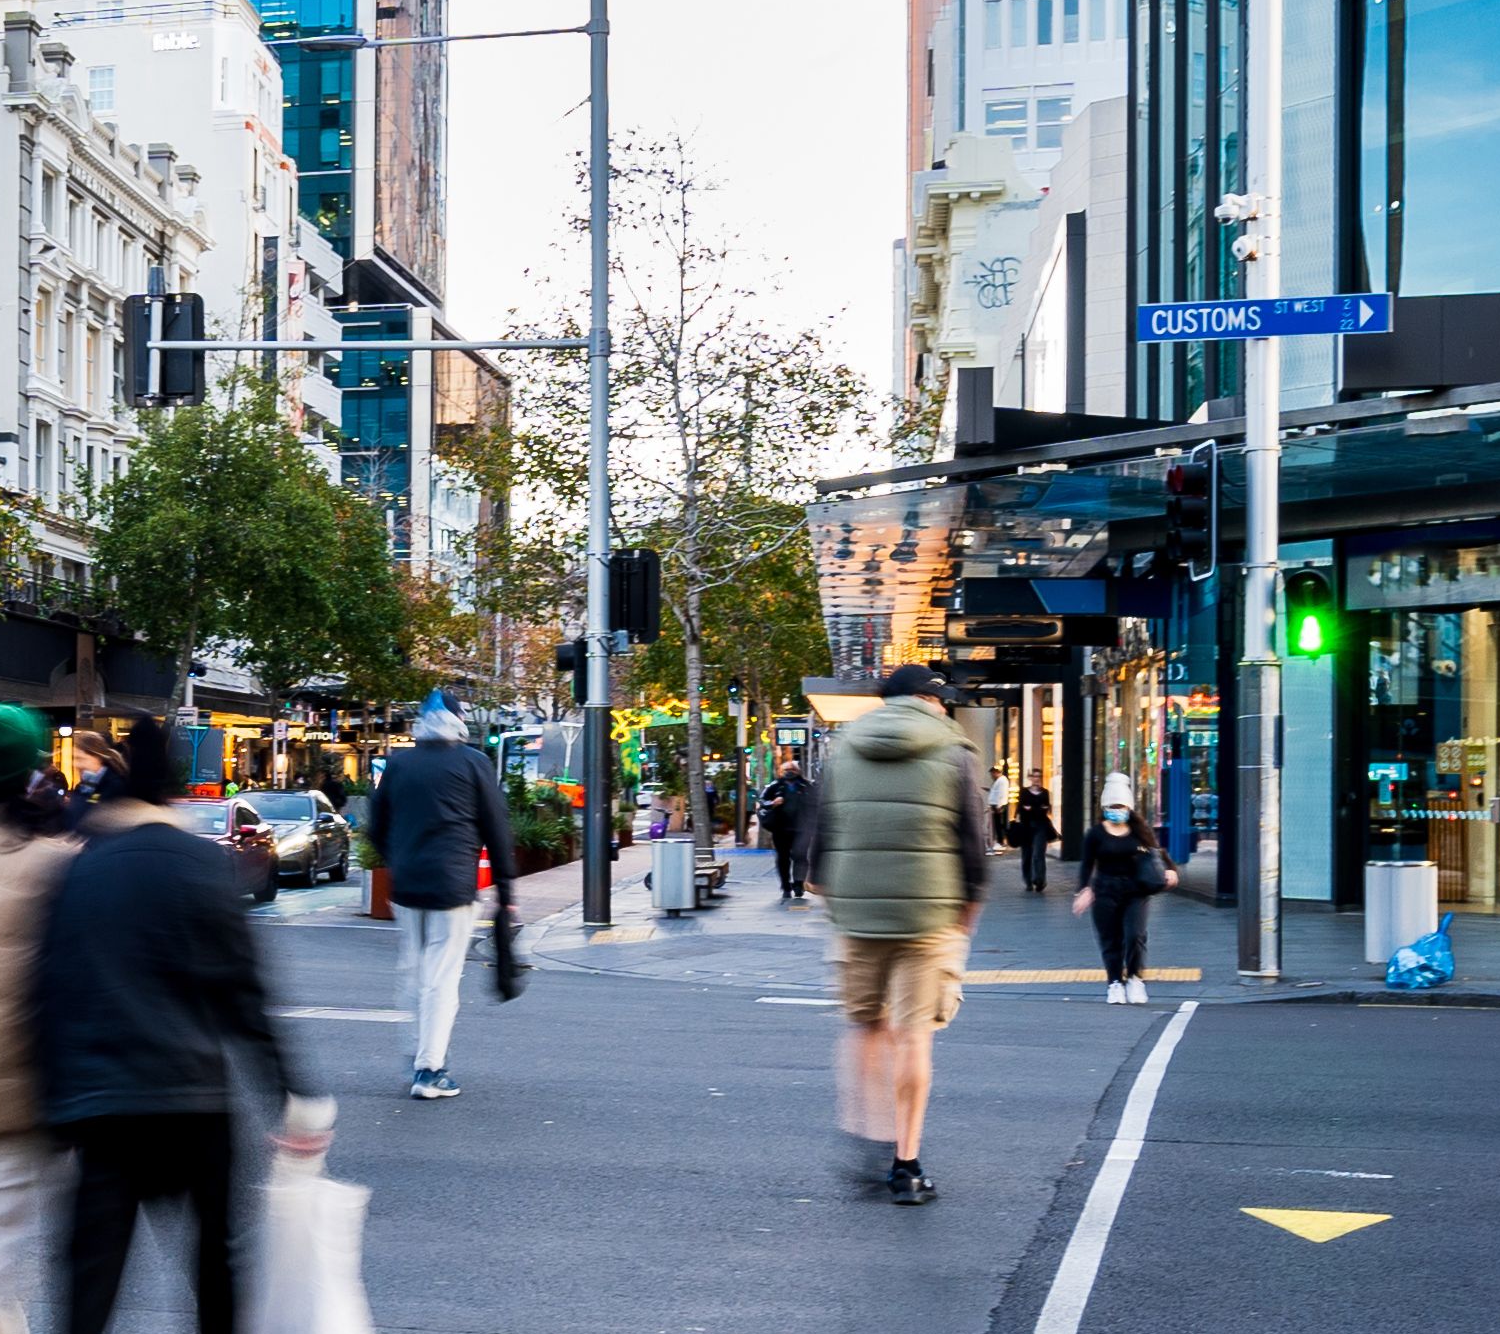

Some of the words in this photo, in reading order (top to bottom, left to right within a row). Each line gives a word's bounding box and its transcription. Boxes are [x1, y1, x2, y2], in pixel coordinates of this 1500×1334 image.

[1344, 299, 1351, 309] 2
[1151, 306, 1261, 335] CUSTOMS
[1274, 301, 1289, 314] ST
[1293, 299, 1326, 313] WEST
[1340, 319, 1354, 330] 22
